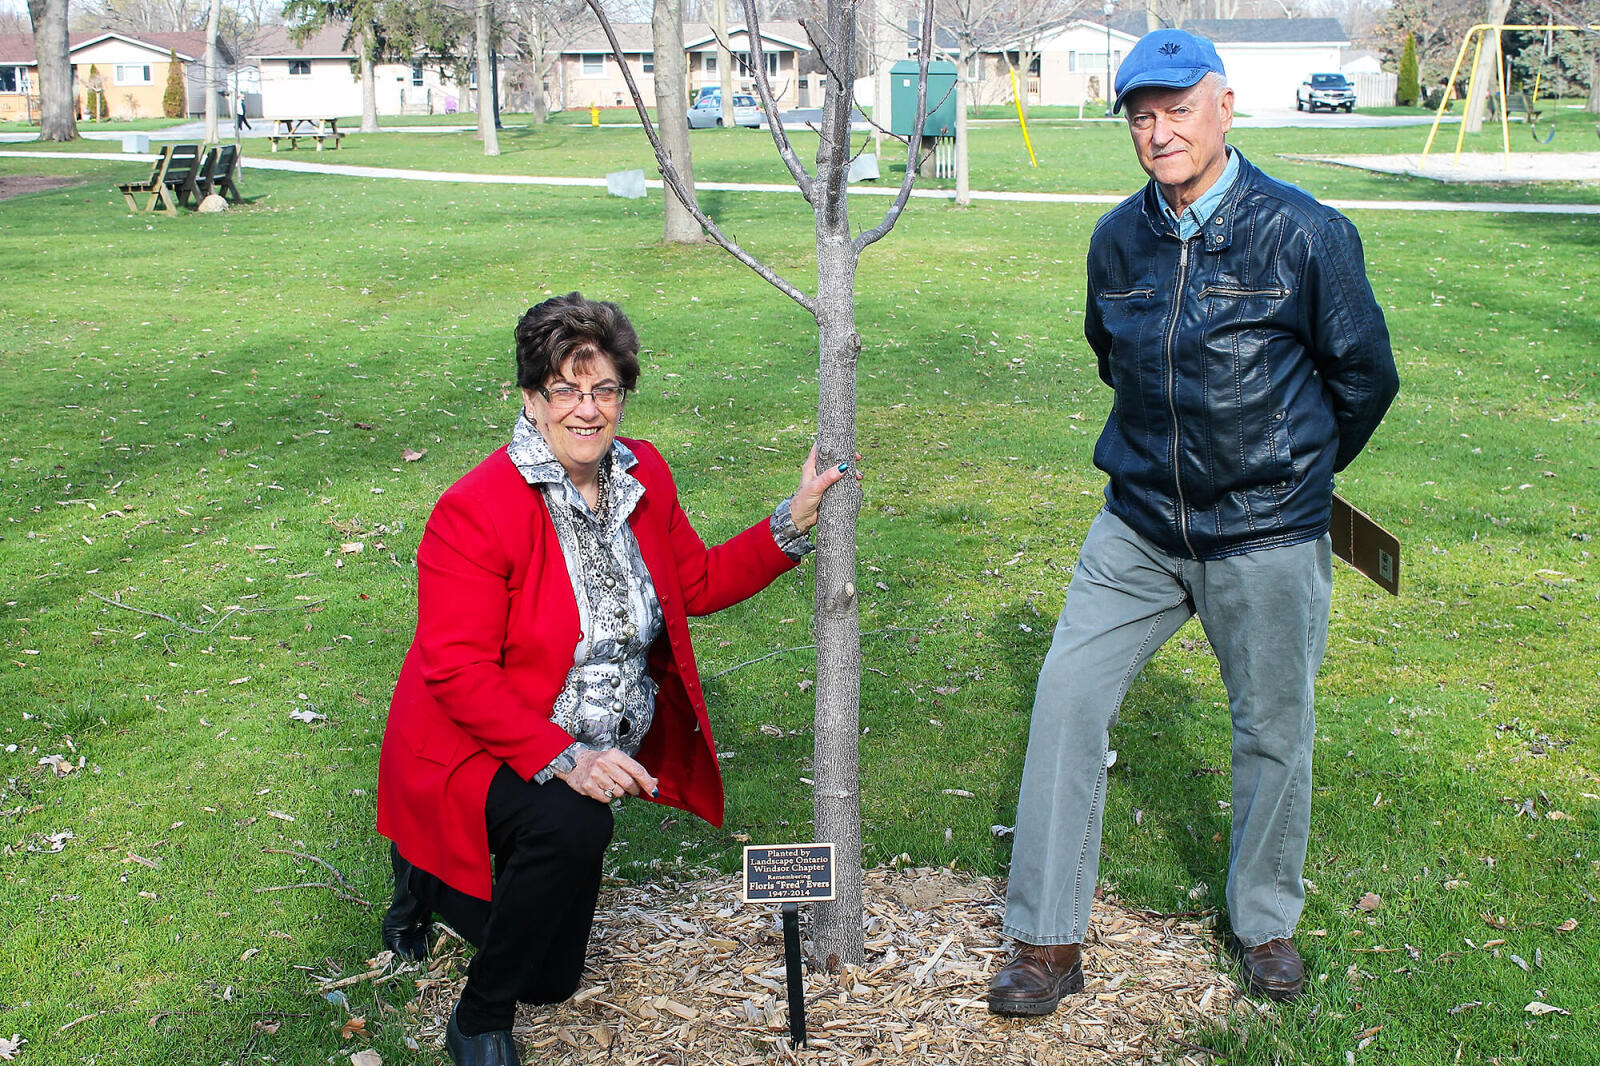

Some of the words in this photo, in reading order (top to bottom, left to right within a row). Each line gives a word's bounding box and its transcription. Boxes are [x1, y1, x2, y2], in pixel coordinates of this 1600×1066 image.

[800, 849, 811, 857] by
[750, 858, 794, 866] Landscape
[795, 856, 829, 864] Ontario
[753, 865, 790, 873] Windsor
[791, 864, 825, 872] Chapter
[749, 882, 775, 890] Floris
[806, 880, 830, 888] Evers
[768, 889, 811, 897] 1947-2014
